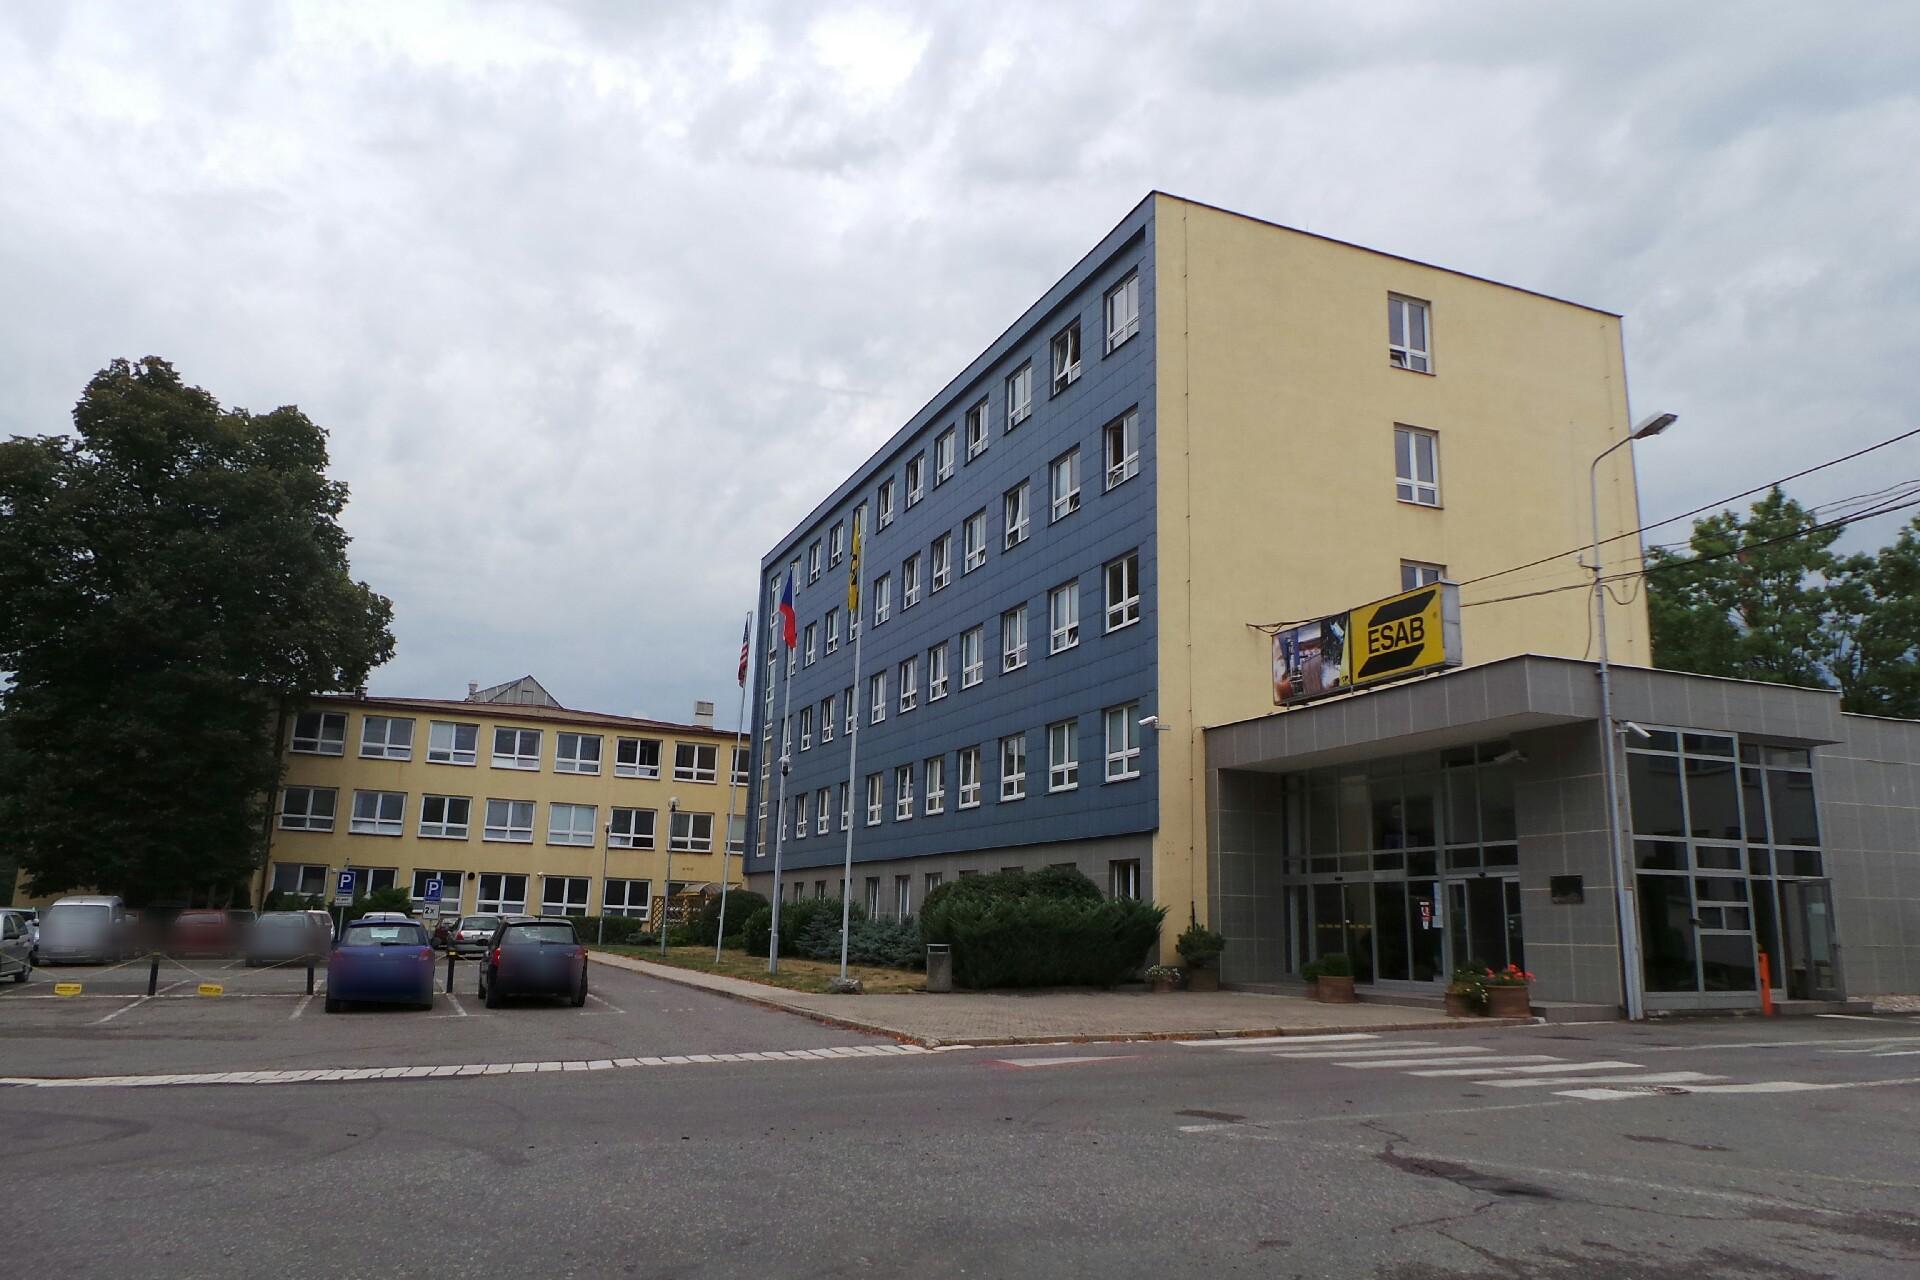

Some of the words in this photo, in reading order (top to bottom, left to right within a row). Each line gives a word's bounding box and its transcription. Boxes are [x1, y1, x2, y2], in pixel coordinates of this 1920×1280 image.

[1368, 617, 1424, 654] ESAB
[340, 874, 351, 888] P
[428, 881, 439, 896] P
